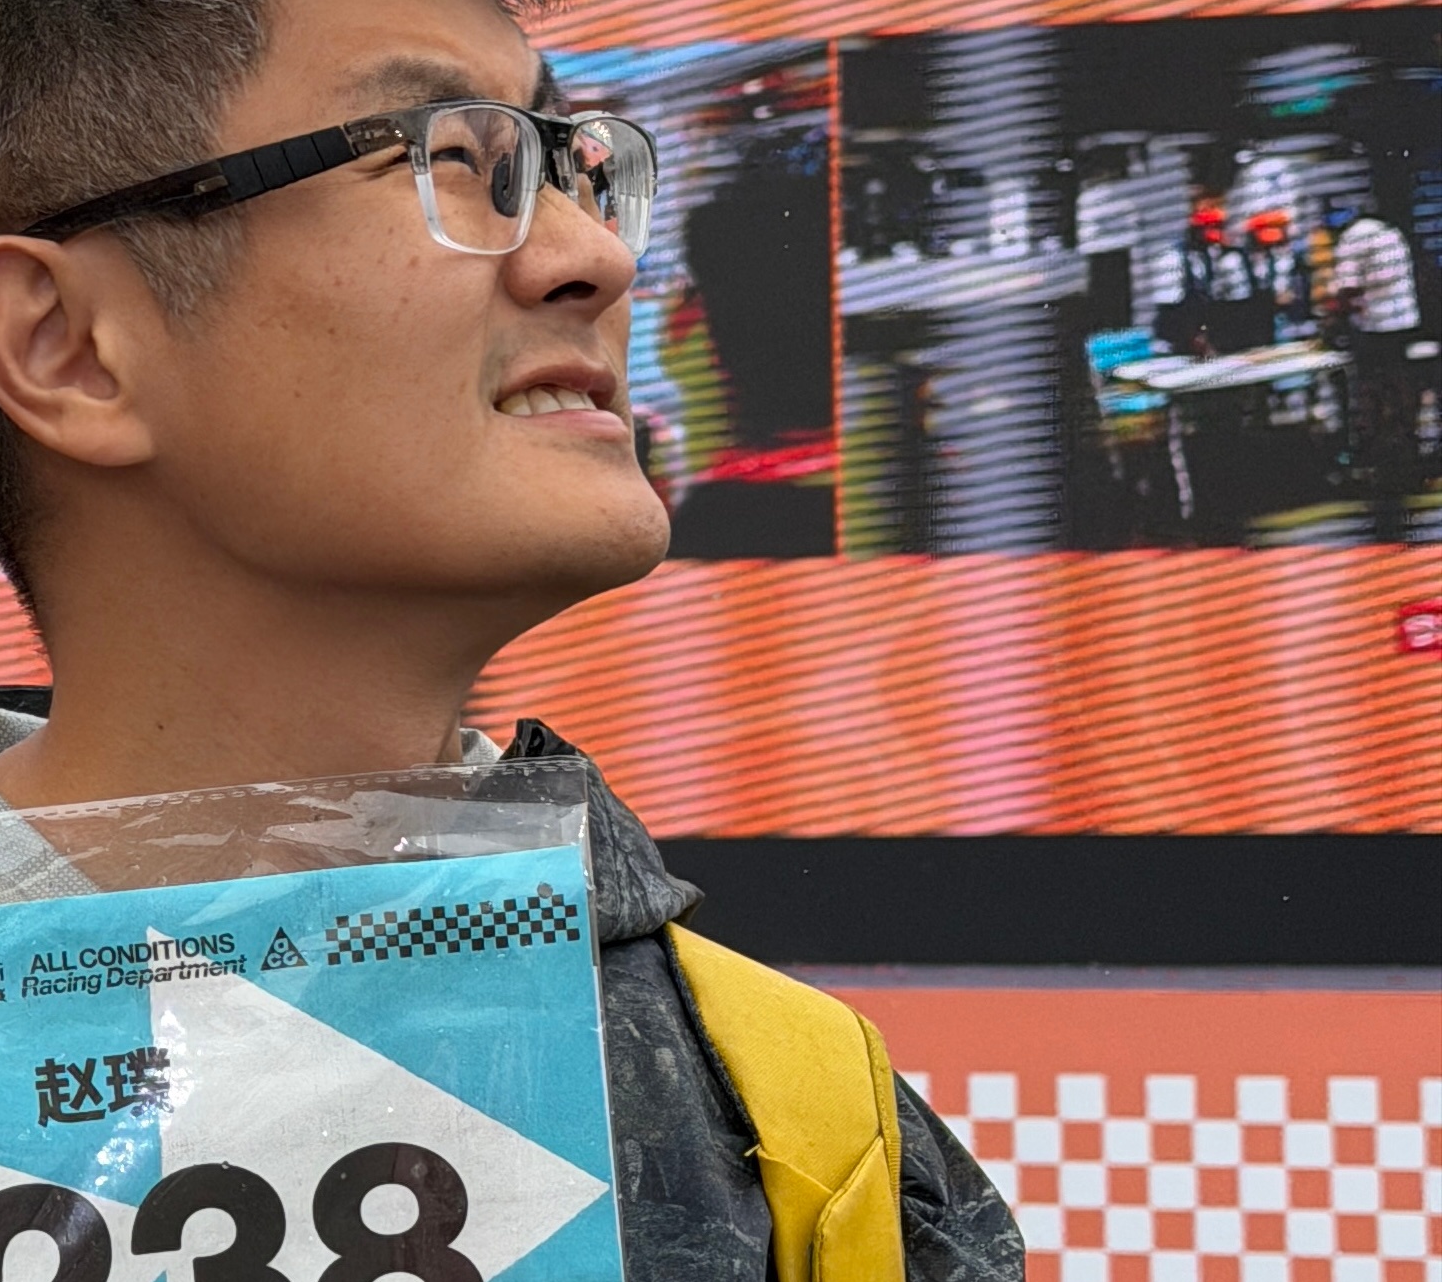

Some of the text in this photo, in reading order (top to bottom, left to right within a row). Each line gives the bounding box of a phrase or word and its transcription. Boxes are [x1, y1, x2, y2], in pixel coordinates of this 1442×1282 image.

[30, 933, 236, 974] ALL CONDITIONS
[21, 955, 247, 997] Racing Department
